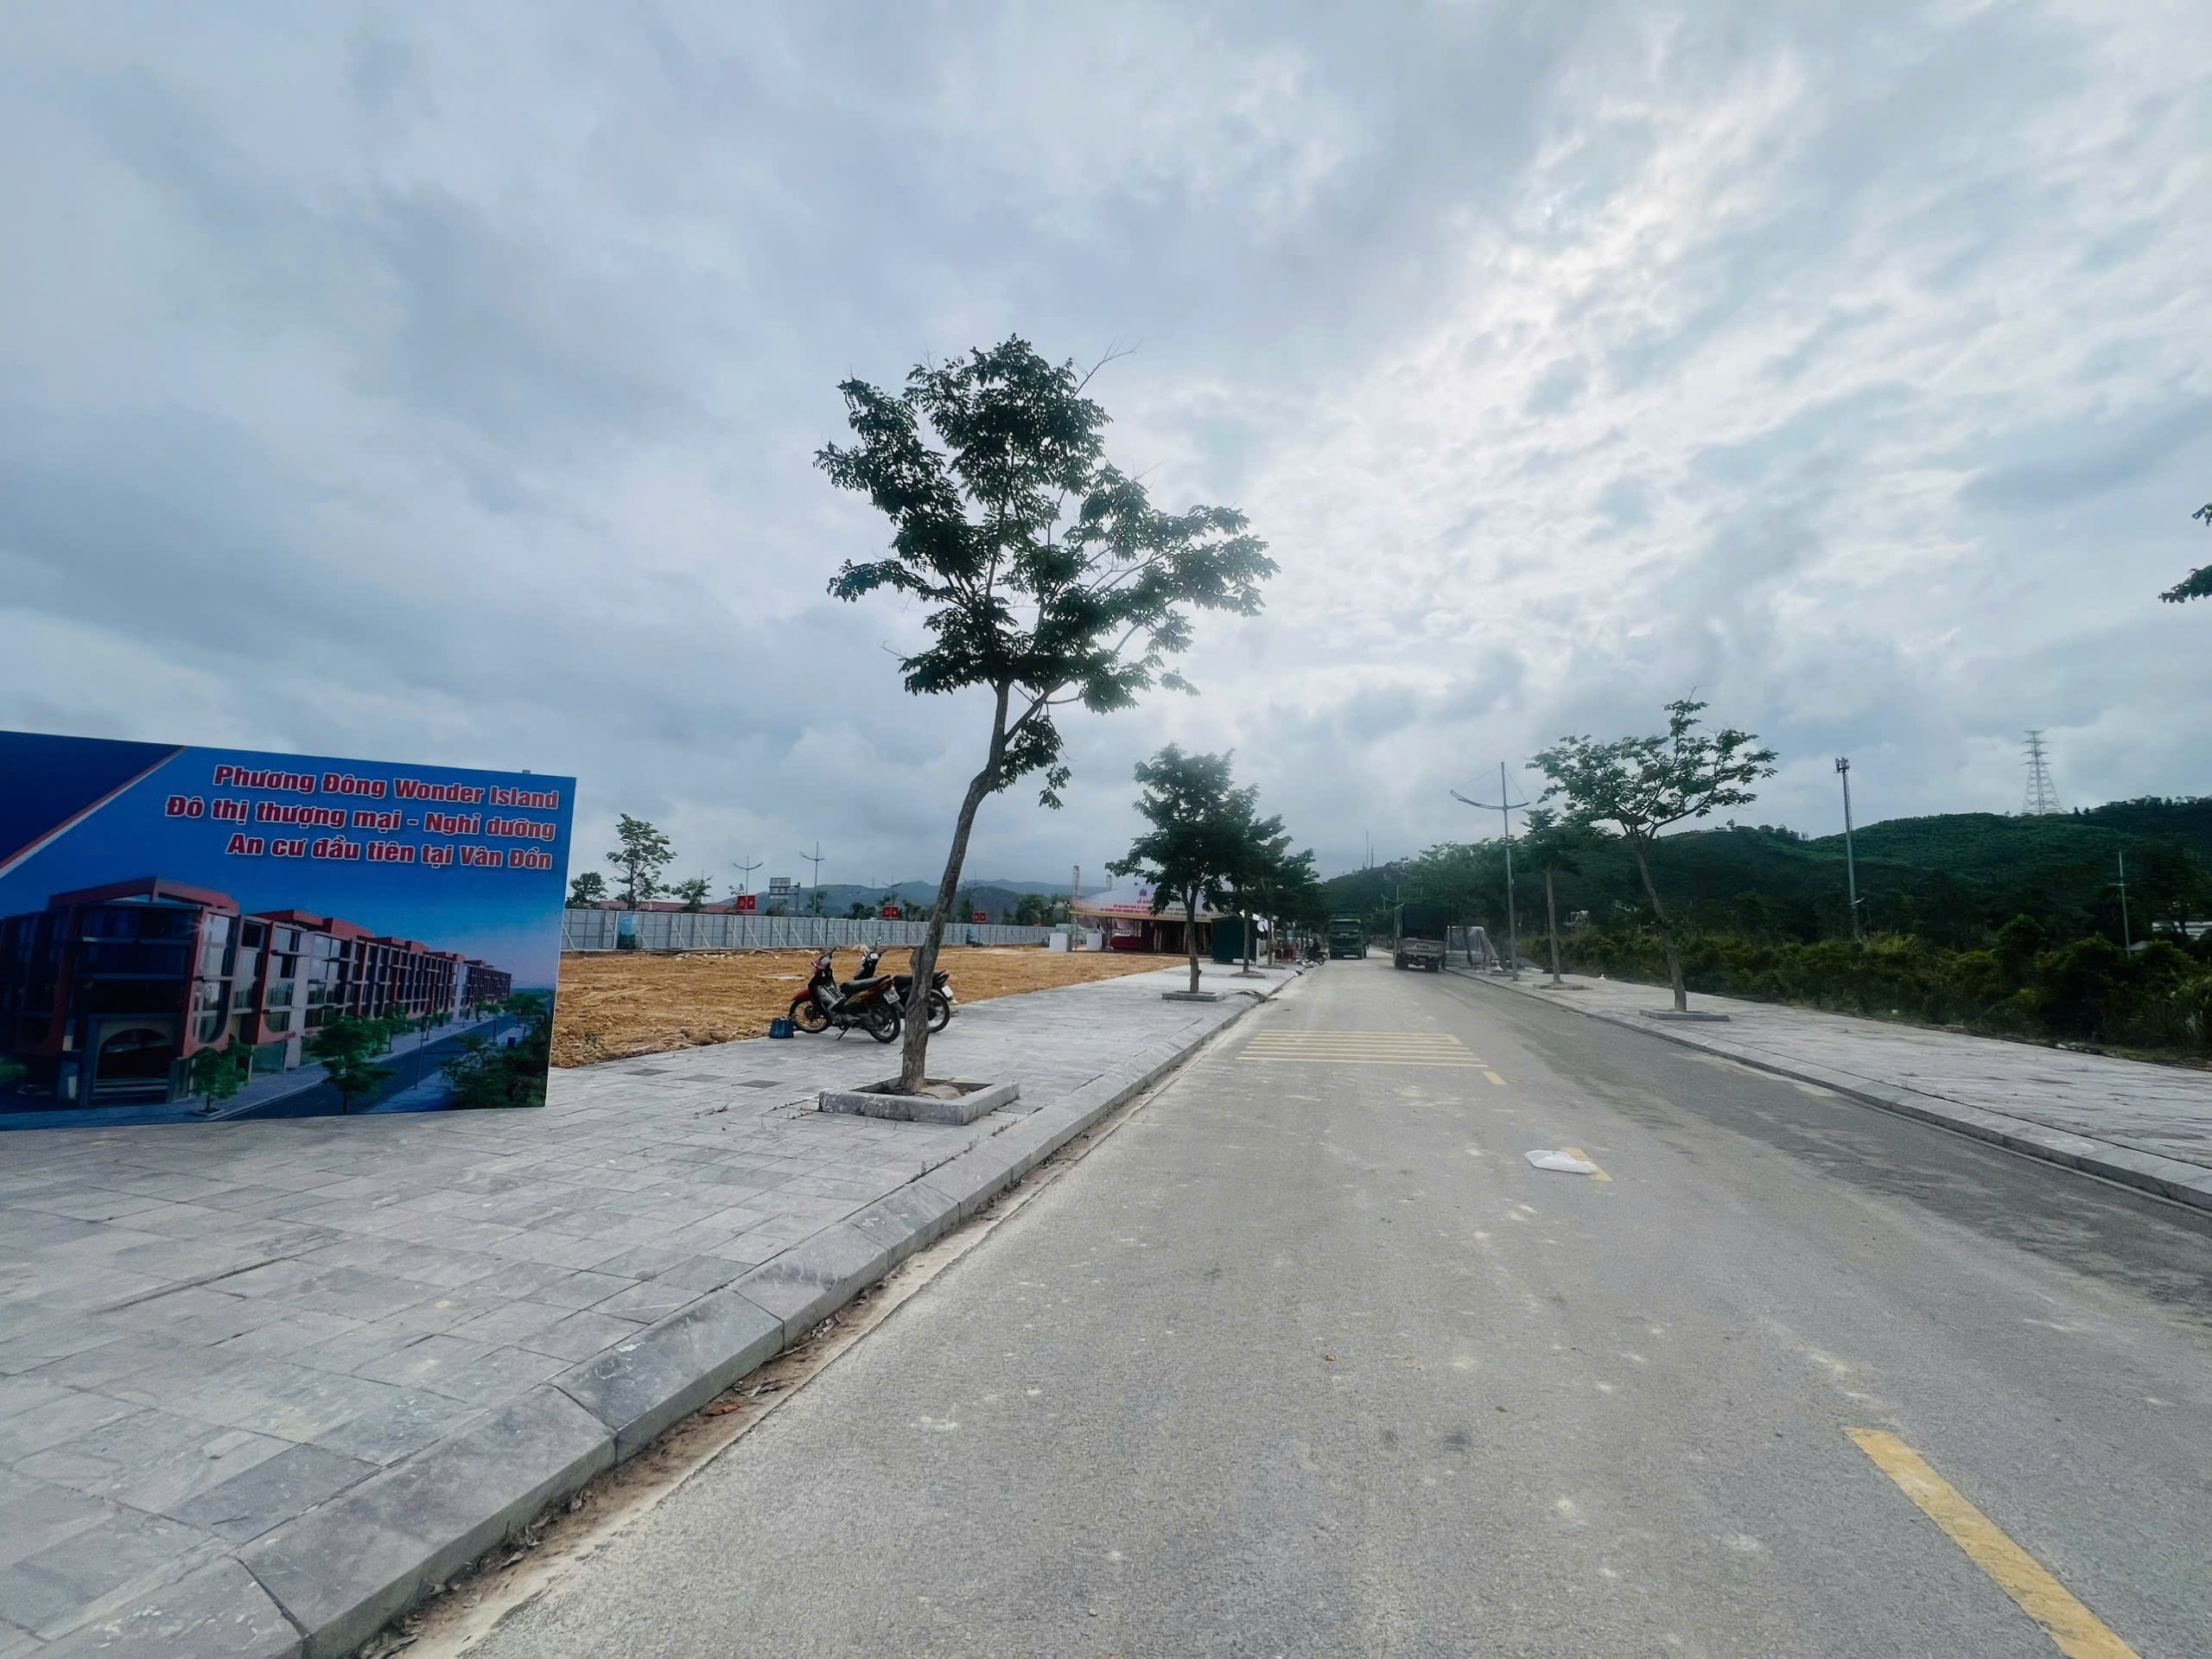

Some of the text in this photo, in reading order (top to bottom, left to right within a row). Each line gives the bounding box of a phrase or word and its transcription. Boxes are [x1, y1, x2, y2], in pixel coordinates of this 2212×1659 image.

[213, 764, 559, 810] Phương Đông Wonder Island
[165, 794, 204, 818] Đô
[211, 798, 250, 825] thị
[256, 801, 346, 830] thượng
[352, 810, 402, 834] mại
[423, 811, 481, 836] Nghỉ
[486, 817, 556, 842] dưỡng
[226, 833, 553, 870] An cư đầu tiên tại Vân Đồn
